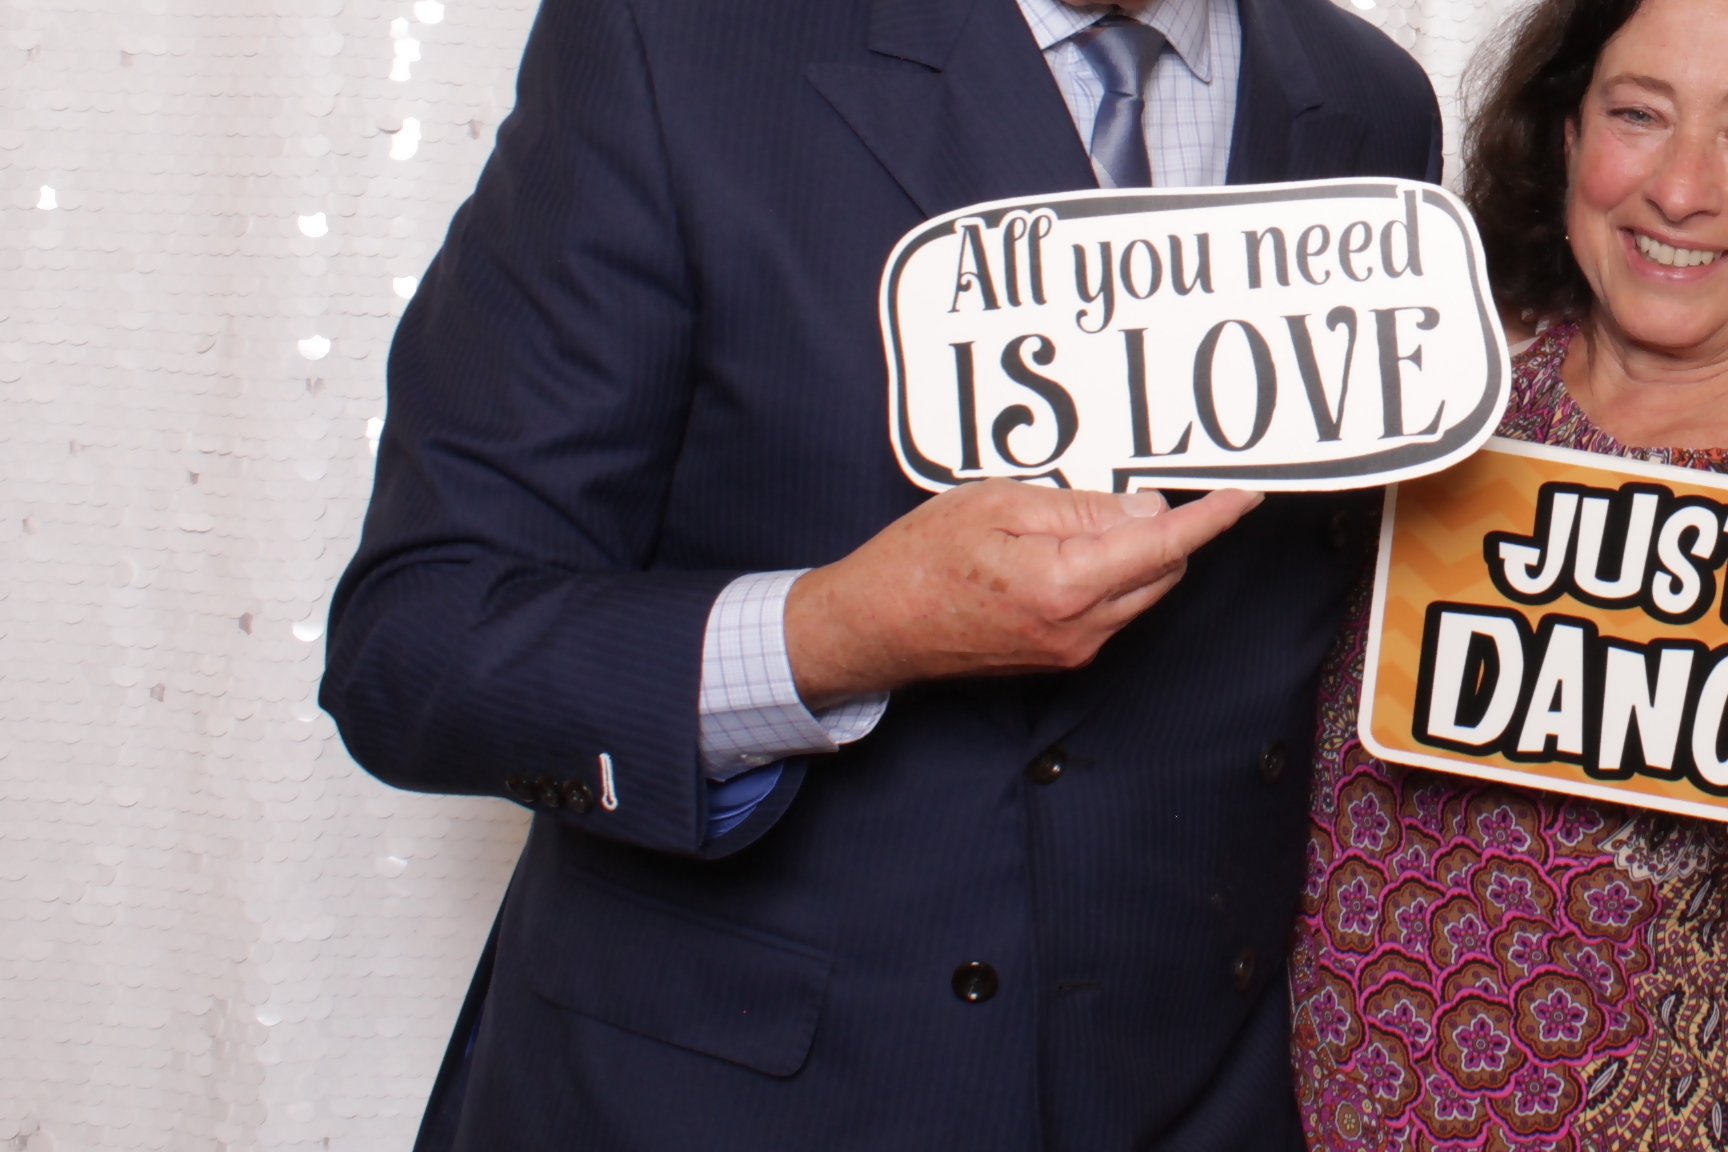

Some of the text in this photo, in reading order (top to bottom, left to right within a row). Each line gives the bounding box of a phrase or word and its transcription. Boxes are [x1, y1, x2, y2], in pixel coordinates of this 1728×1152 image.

[948, 189, 1423, 334] All you need
[949, 306, 1446, 471] IS LOVE
